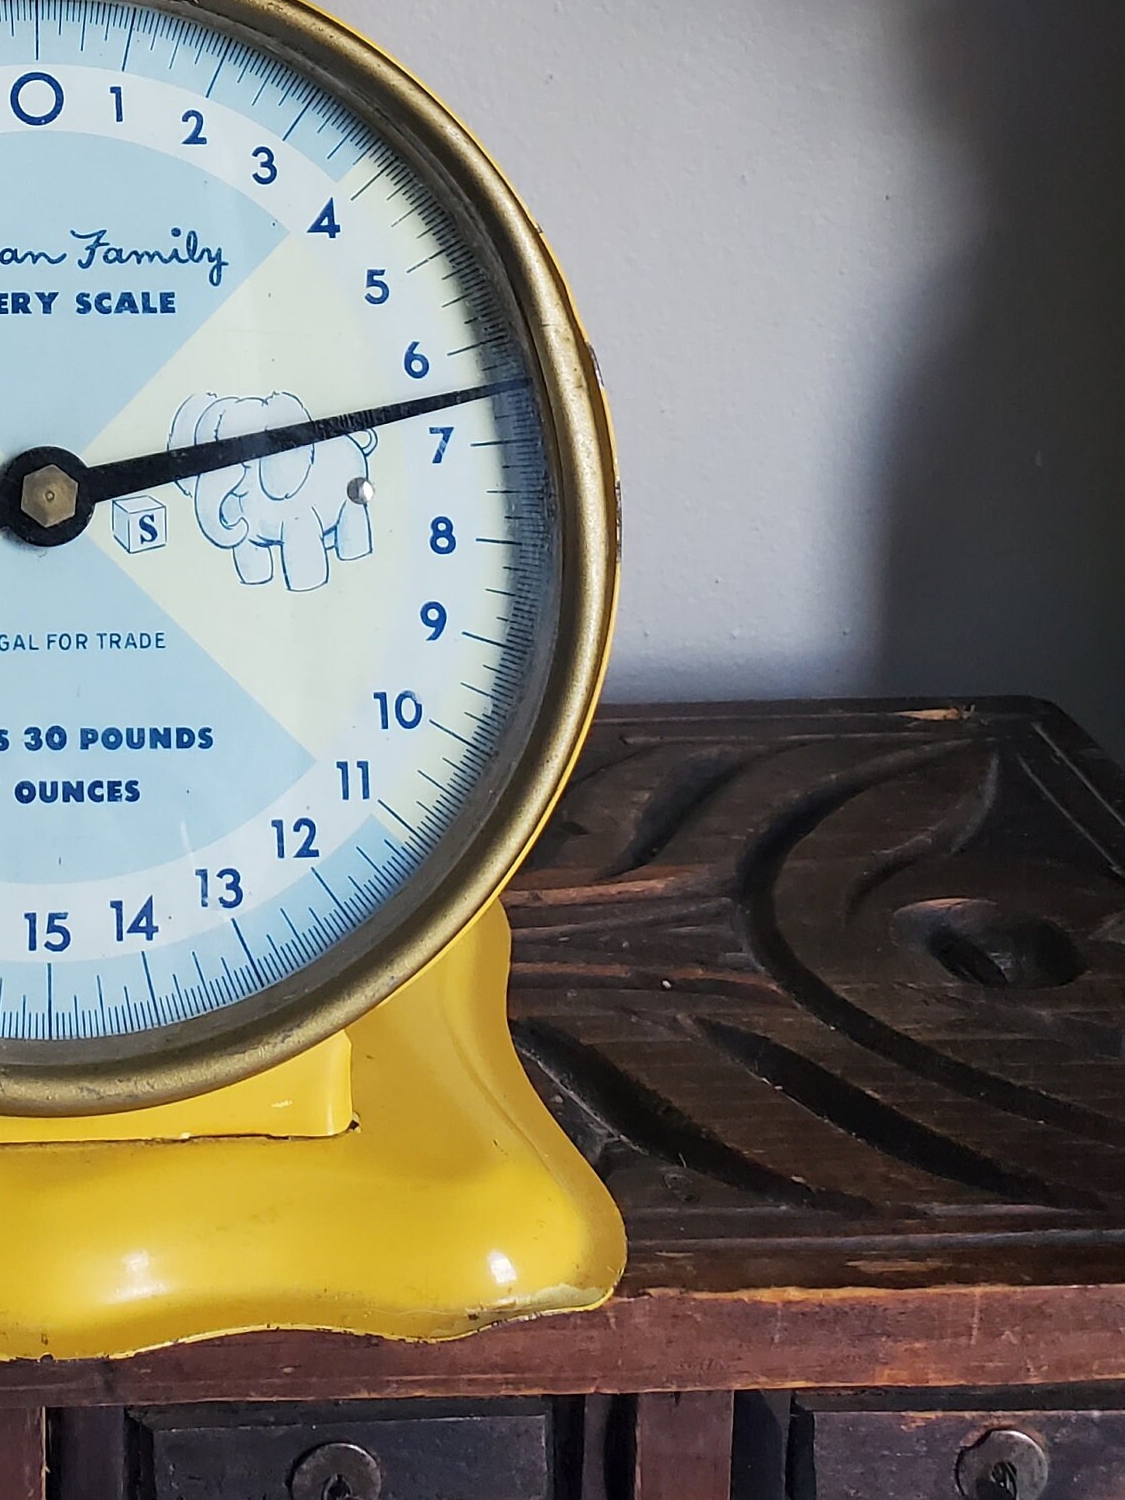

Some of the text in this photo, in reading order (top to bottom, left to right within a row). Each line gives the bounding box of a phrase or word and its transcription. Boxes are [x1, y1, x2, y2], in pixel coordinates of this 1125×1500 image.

[109, 86, 124, 123] 1
[181, 109, 208, 145] 2
[251, 146, 278, 185] 3
[306, 197, 341, 239] 4
[70, 227, 229, 287] Family
[75, 291, 176, 315] SCALE
[364, 269, 390, 305] 5
[403, 341, 430, 380] 6
[428, 426, 455, 464] 7
[138, 514, 158, 545] S
[429, 516, 457, 555] 8
[420, 601, 448, 641] 9
[47, 633, 88, 651] FOR
[96, 632, 166, 650] TRADE
[373, 690, 423, 730] 10
[23, 725, 68, 752] 30
[79, 727, 214, 751] POUNDS
[14, 779, 141, 805] OUNCES
[336, 760, 370, 801] 11
[271, 817, 320, 859] 12
[195, 868, 244, 909] 13
[23, 912, 71, 952] 15
[109, 895, 159, 942] 14
